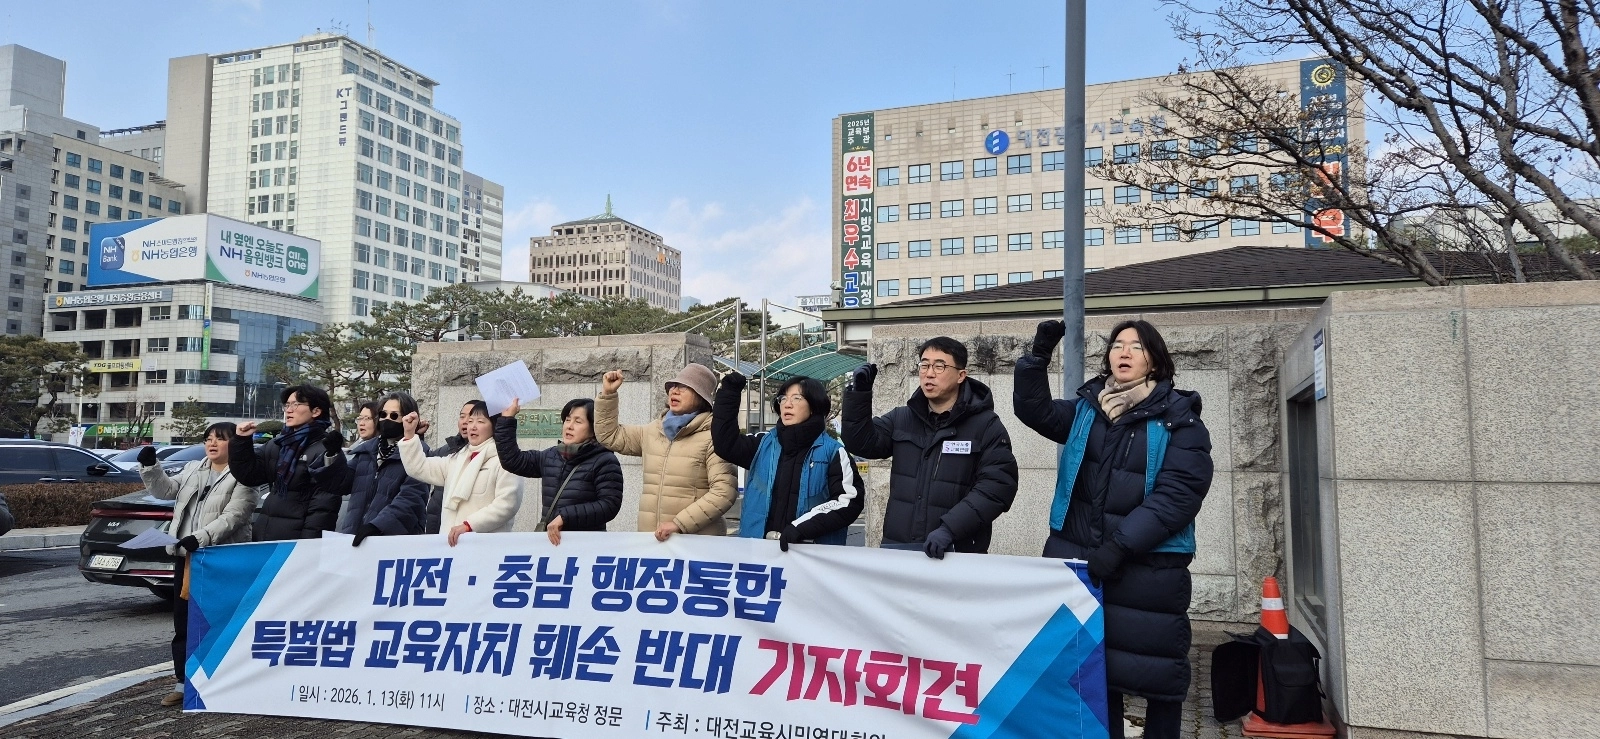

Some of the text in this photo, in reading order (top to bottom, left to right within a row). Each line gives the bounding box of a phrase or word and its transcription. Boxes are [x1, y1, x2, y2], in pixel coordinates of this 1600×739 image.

[336, 87, 352, 98] KT
[847, 119, 869, 128] 2025년
[846, 156, 871, 172] 6년
[845, 174, 871, 191] 연속
[220, 230, 284, 255] 내 옆엔 오늘도
[102, 254, 118, 263] Bank
[142, 246, 198, 260] NH농협은행
[220, 245, 284, 268] NH올원뱅크
[288, 251, 300, 259] all
[288, 259, 306, 270] one
[251, 271, 286, 283] NH농협은행
[63, 294, 104, 305] NH농협은행
[373, 558, 453, 608] 대전
[492, 555, 579, 609] 충남
[591, 556, 787, 623] 행정통합
[251, 620, 982, 725] 특별법 교육자치 훼손 반대 기자회견
[299, 685, 320, 702] 일시
[330, 687, 362, 705] 2026.
[367, 690, 376, 706] 1.
[381, 690, 414, 709] 13(화)
[420, 692, 445, 711] 11시
[473, 695, 495, 715] 장소
[508, 698, 590, 724] 대전시교육청
[594, 703, 623, 727] 정문
[656, 711, 689, 734] 주최
